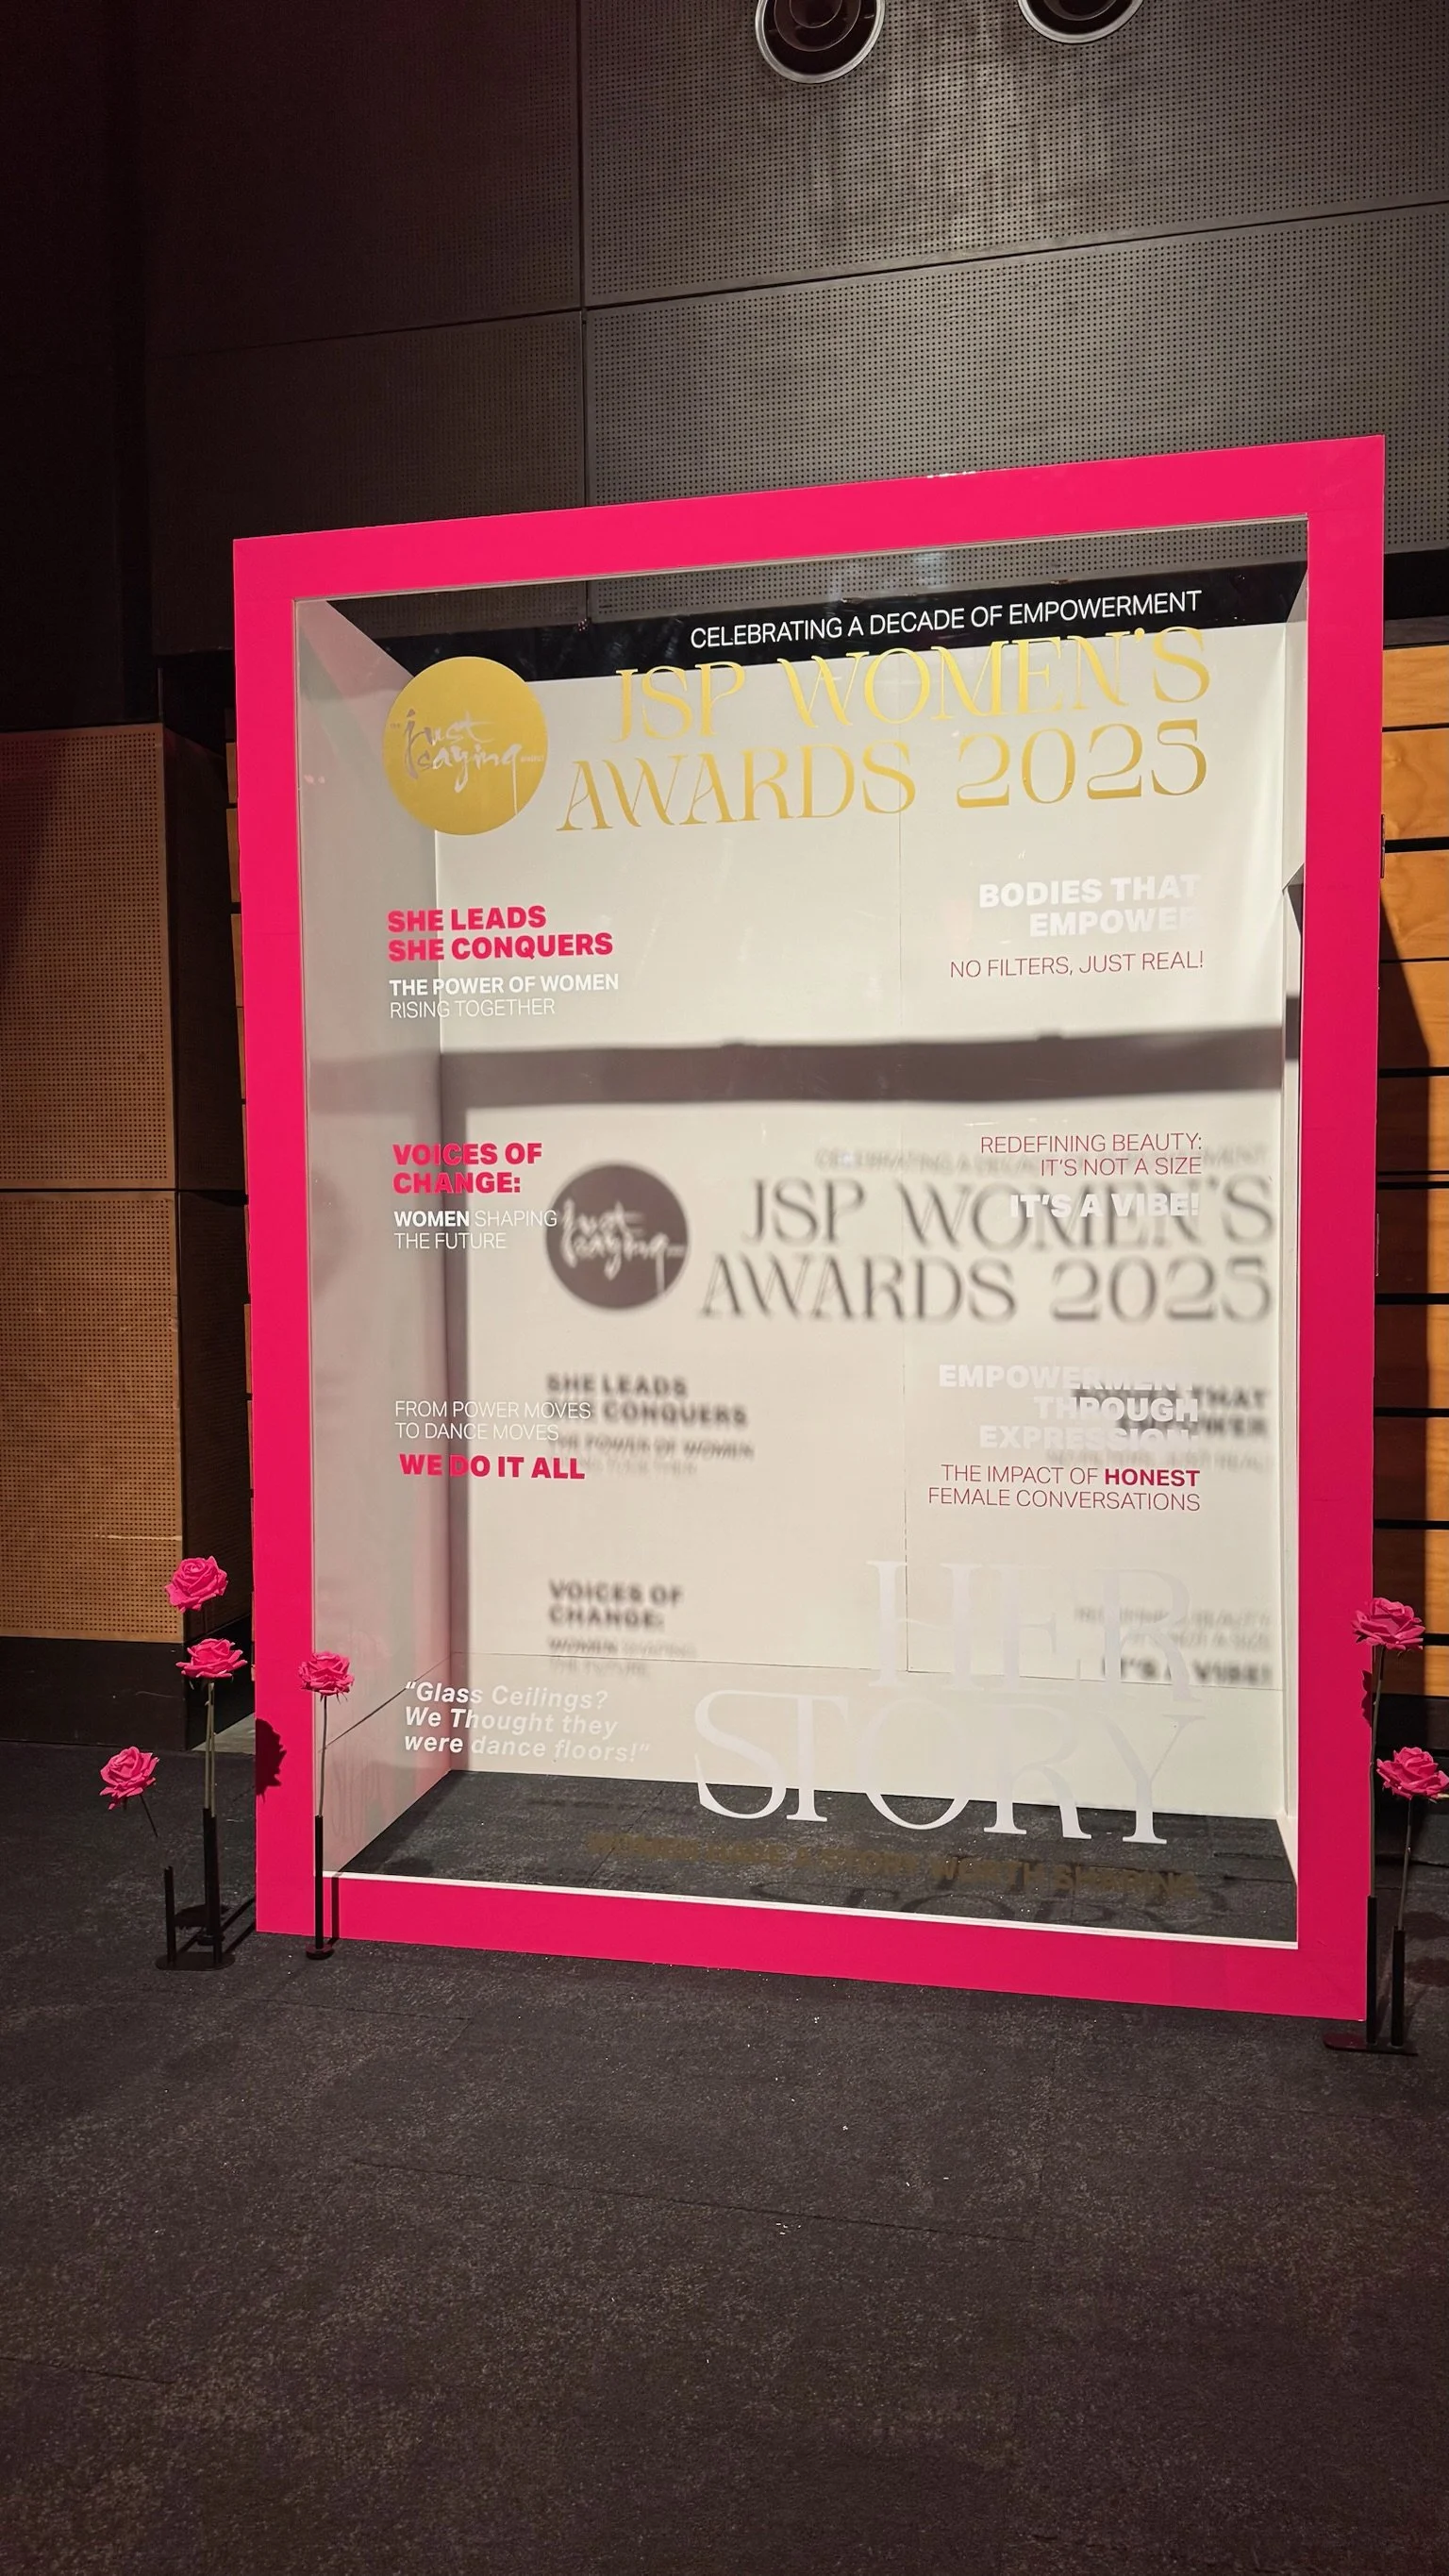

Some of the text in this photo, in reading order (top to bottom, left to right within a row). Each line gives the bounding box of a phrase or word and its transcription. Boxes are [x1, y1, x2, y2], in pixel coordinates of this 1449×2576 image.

[691, 590, 1203, 649] CELEBRATING A DECADE OF EMPOWERMENT
[608, 626, 1211, 744] JSP WOMEN'S
[417, 743, 523, 813] saying
[556, 719, 1208, 831] AWARDS 2025
[978, 873, 1202, 908] BODIES THAT
[387, 905, 547, 933] SHE LEADS
[388, 932, 614, 962] SHE CONQUERS
[950, 950, 1204, 979] NO FILTERS, JUST REAL!
[389, 973, 619, 996] THE POWER OF WOMEN
[390, 997, 556, 1019] RISING TOGETHER
[391, 1142, 542, 1166] VOICES OF
[980, 1132, 1202, 1154] REDEFINING BEAUTY:
[1041, 1158, 1077, 1177] IT'S
[1084, 1157, 1128, 1177] NOT
[1134, 1157, 1148, 1176] A
[1154, 1156, 1202, 1176] SIZE
[392, 1171, 521, 1195] CHANGE:
[394, 1209, 558, 1228] WOMEN SHAPING
[1009, 1192, 1200, 1219] IT'S A VIBE!
[393, 1231, 508, 1249] THE FUTURE
[938, 1363, 1199, 1392] EMPOWERMENT
[394, 1400, 448, 1418] FROM
[453, 1400, 520, 1419] POWER
[524, 1401, 592, 1420] MOVES
[1033, 1396, 1199, 1423] THROUGH
[394, 1422, 421, 1440] TO
[425, 1422, 489, 1441] DANCE
[493, 1423, 560, 1443] MOVES
[399, 1453, 443, 1476] WE
[448, 1454, 491, 1478] DO
[497, 1456, 525, 1479] IT
[530, 1456, 586, 1480] ALL
[940, 1464, 1201, 1488] THE IMPACT OF HONEST
[928, 1487, 1201, 1512] FEMALE CONVERSATIONS
[866, 1559, 1203, 1703] HER
[491, 1684, 608, 1713] Ceilings?
[405, 1706, 619, 1742] We Thought they
[404, 1734, 464, 1754] were
[471, 1734, 546, 1759] dance
[693, 1689, 1206, 1845] STORY
